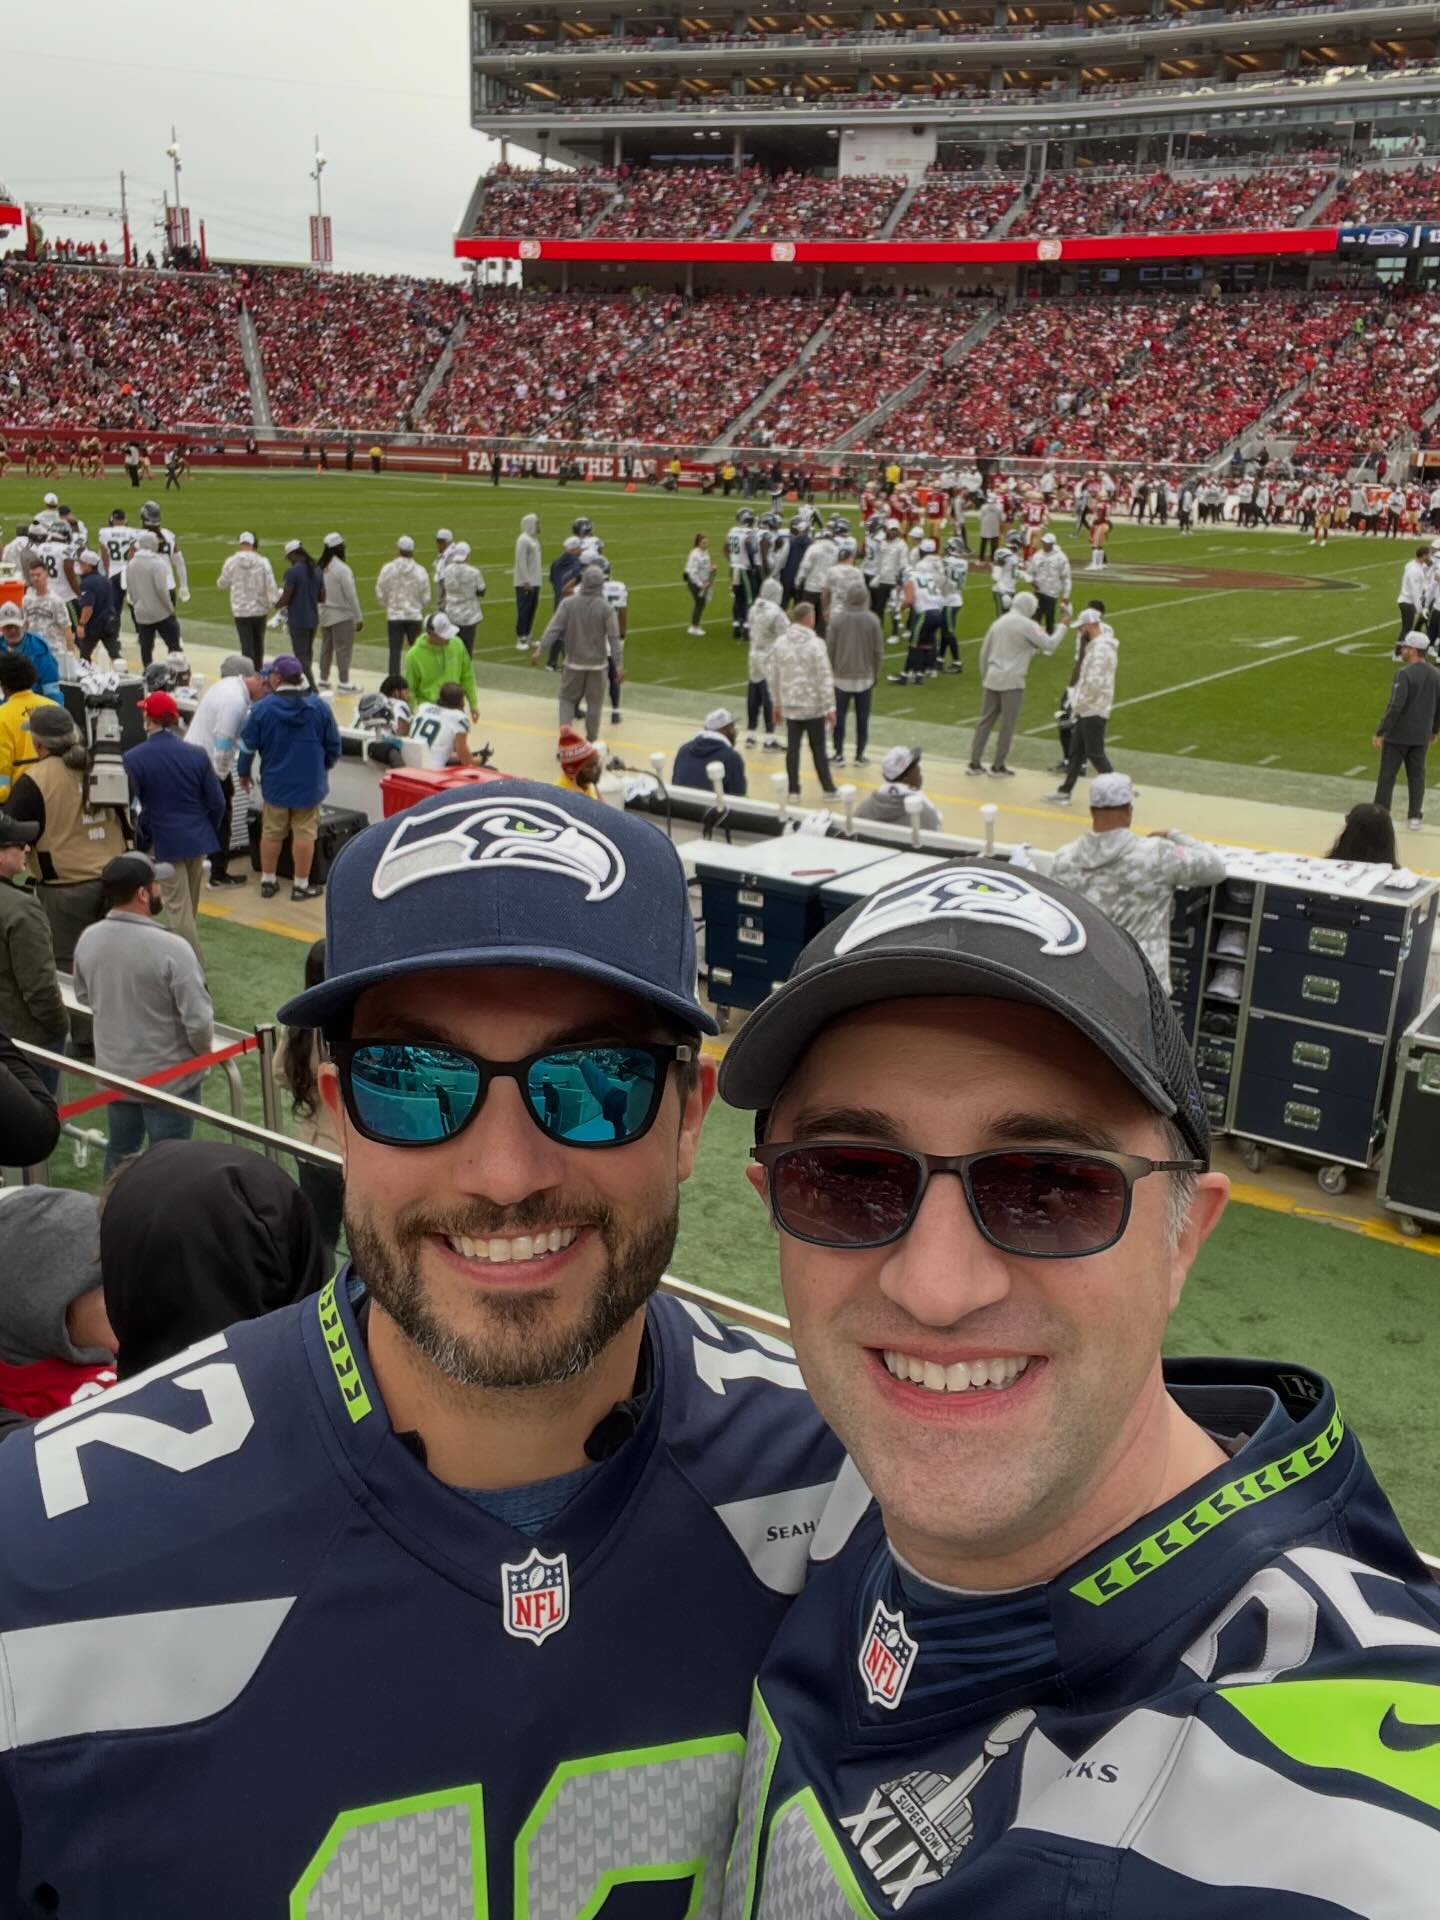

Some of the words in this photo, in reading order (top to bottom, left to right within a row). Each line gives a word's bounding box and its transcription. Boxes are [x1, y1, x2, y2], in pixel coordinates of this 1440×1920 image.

[467, 451, 560, 475] FATHFUL
[574, 457, 614, 477] THE
[411, 716, 441, 750] 19
[766, 1519, 821, 1543] SEAH
[514, 1590, 561, 1629] NFL
[865, 1638, 897, 1697] NFL
[895, 1794, 924, 1830] SUPER
[919, 1823, 945, 1857] BOWL
[839, 1788, 943, 1911] XLIX
